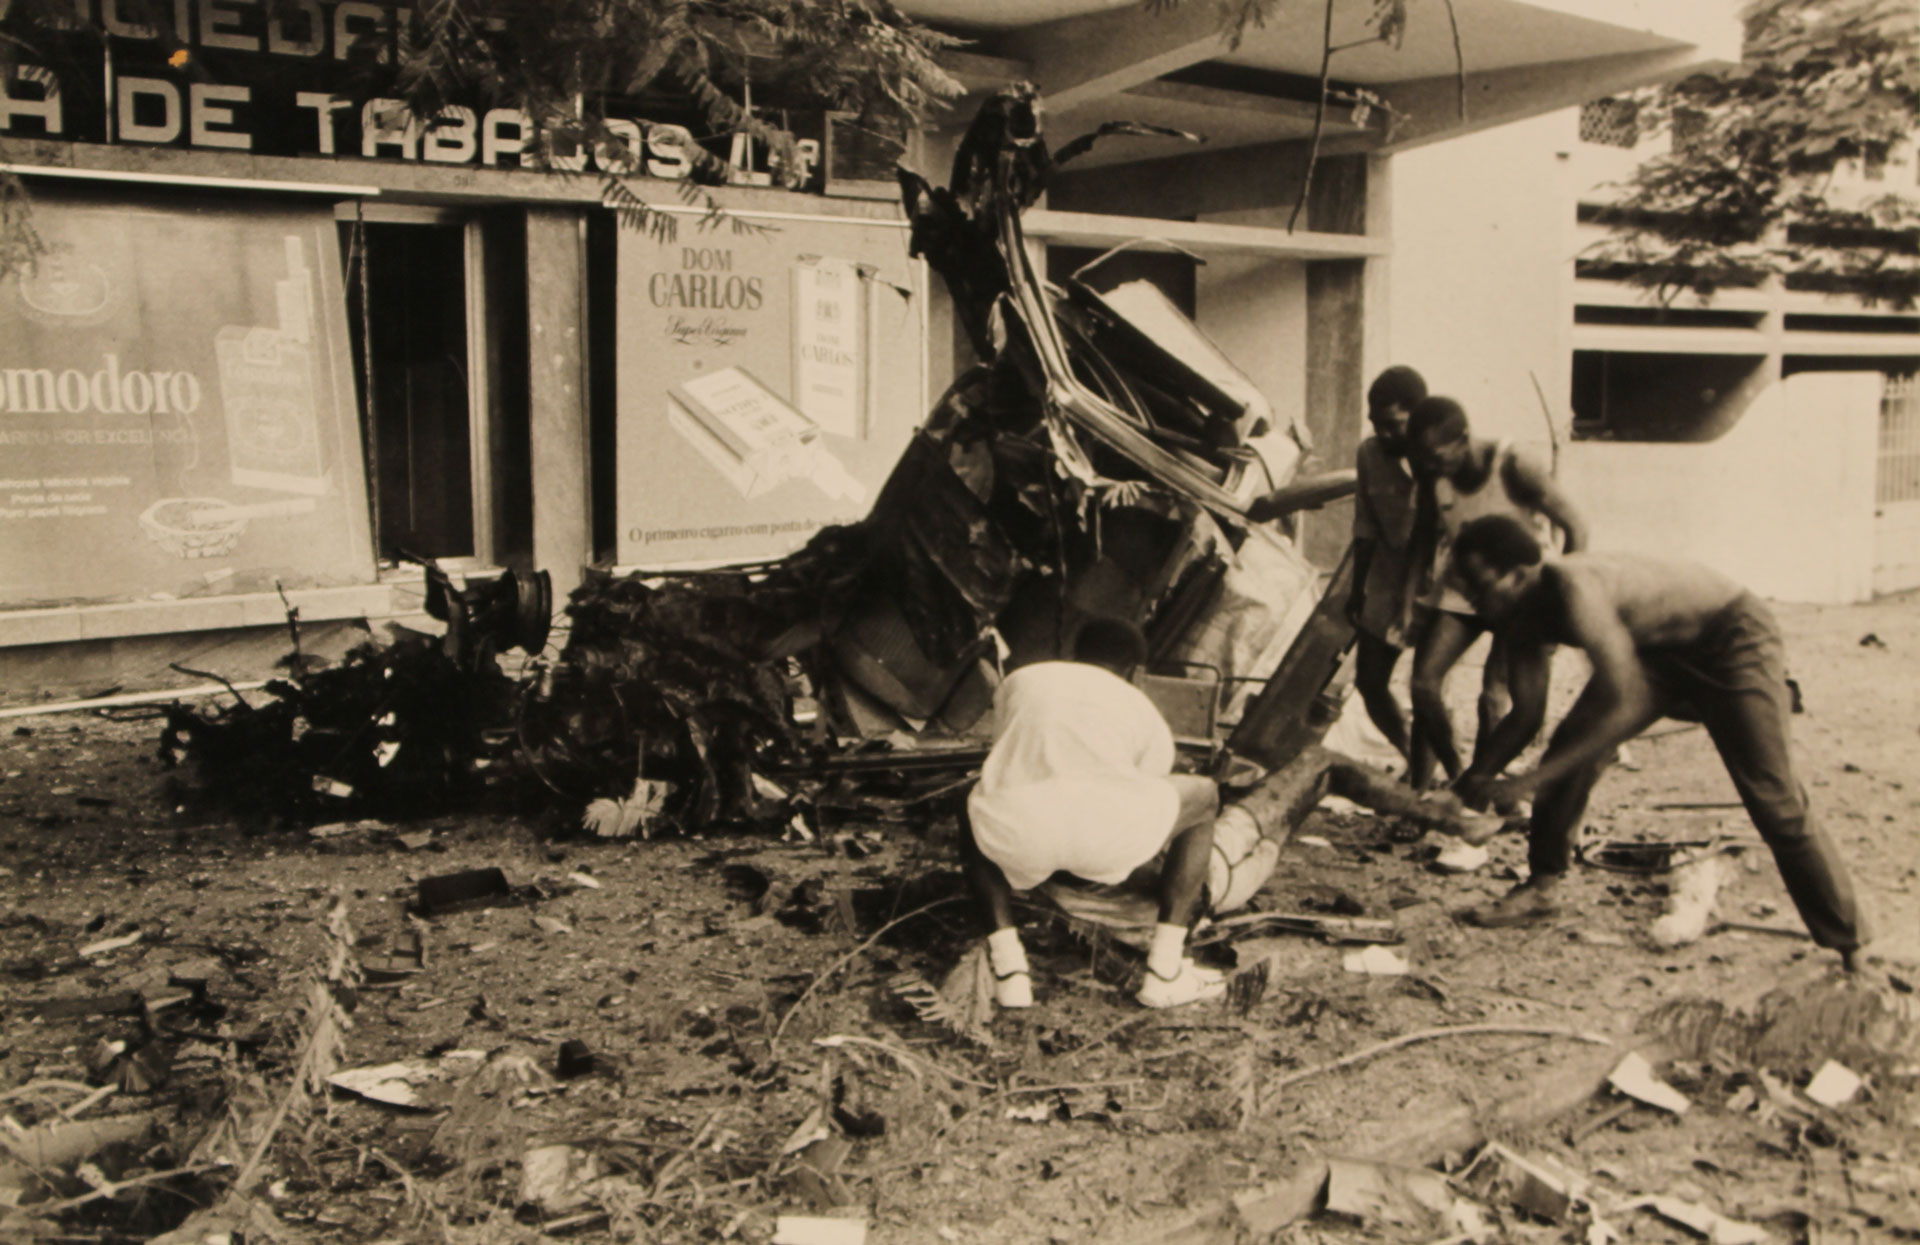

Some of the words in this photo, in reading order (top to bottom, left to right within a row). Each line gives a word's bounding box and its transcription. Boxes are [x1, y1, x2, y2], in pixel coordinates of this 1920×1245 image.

[117, 76, 252, 149] DE
[682, 247, 732, 272] DOM
[648, 271, 763, 311] CARLOS
[0, 352, 201, 415] modoro
[628, 528, 642, 542] O
[645, 528, 698, 546] primeiro
[700, 525, 742, 541] cigarro
[743, 523, 769, 535] com
[770, 519, 802, 537] ponta
